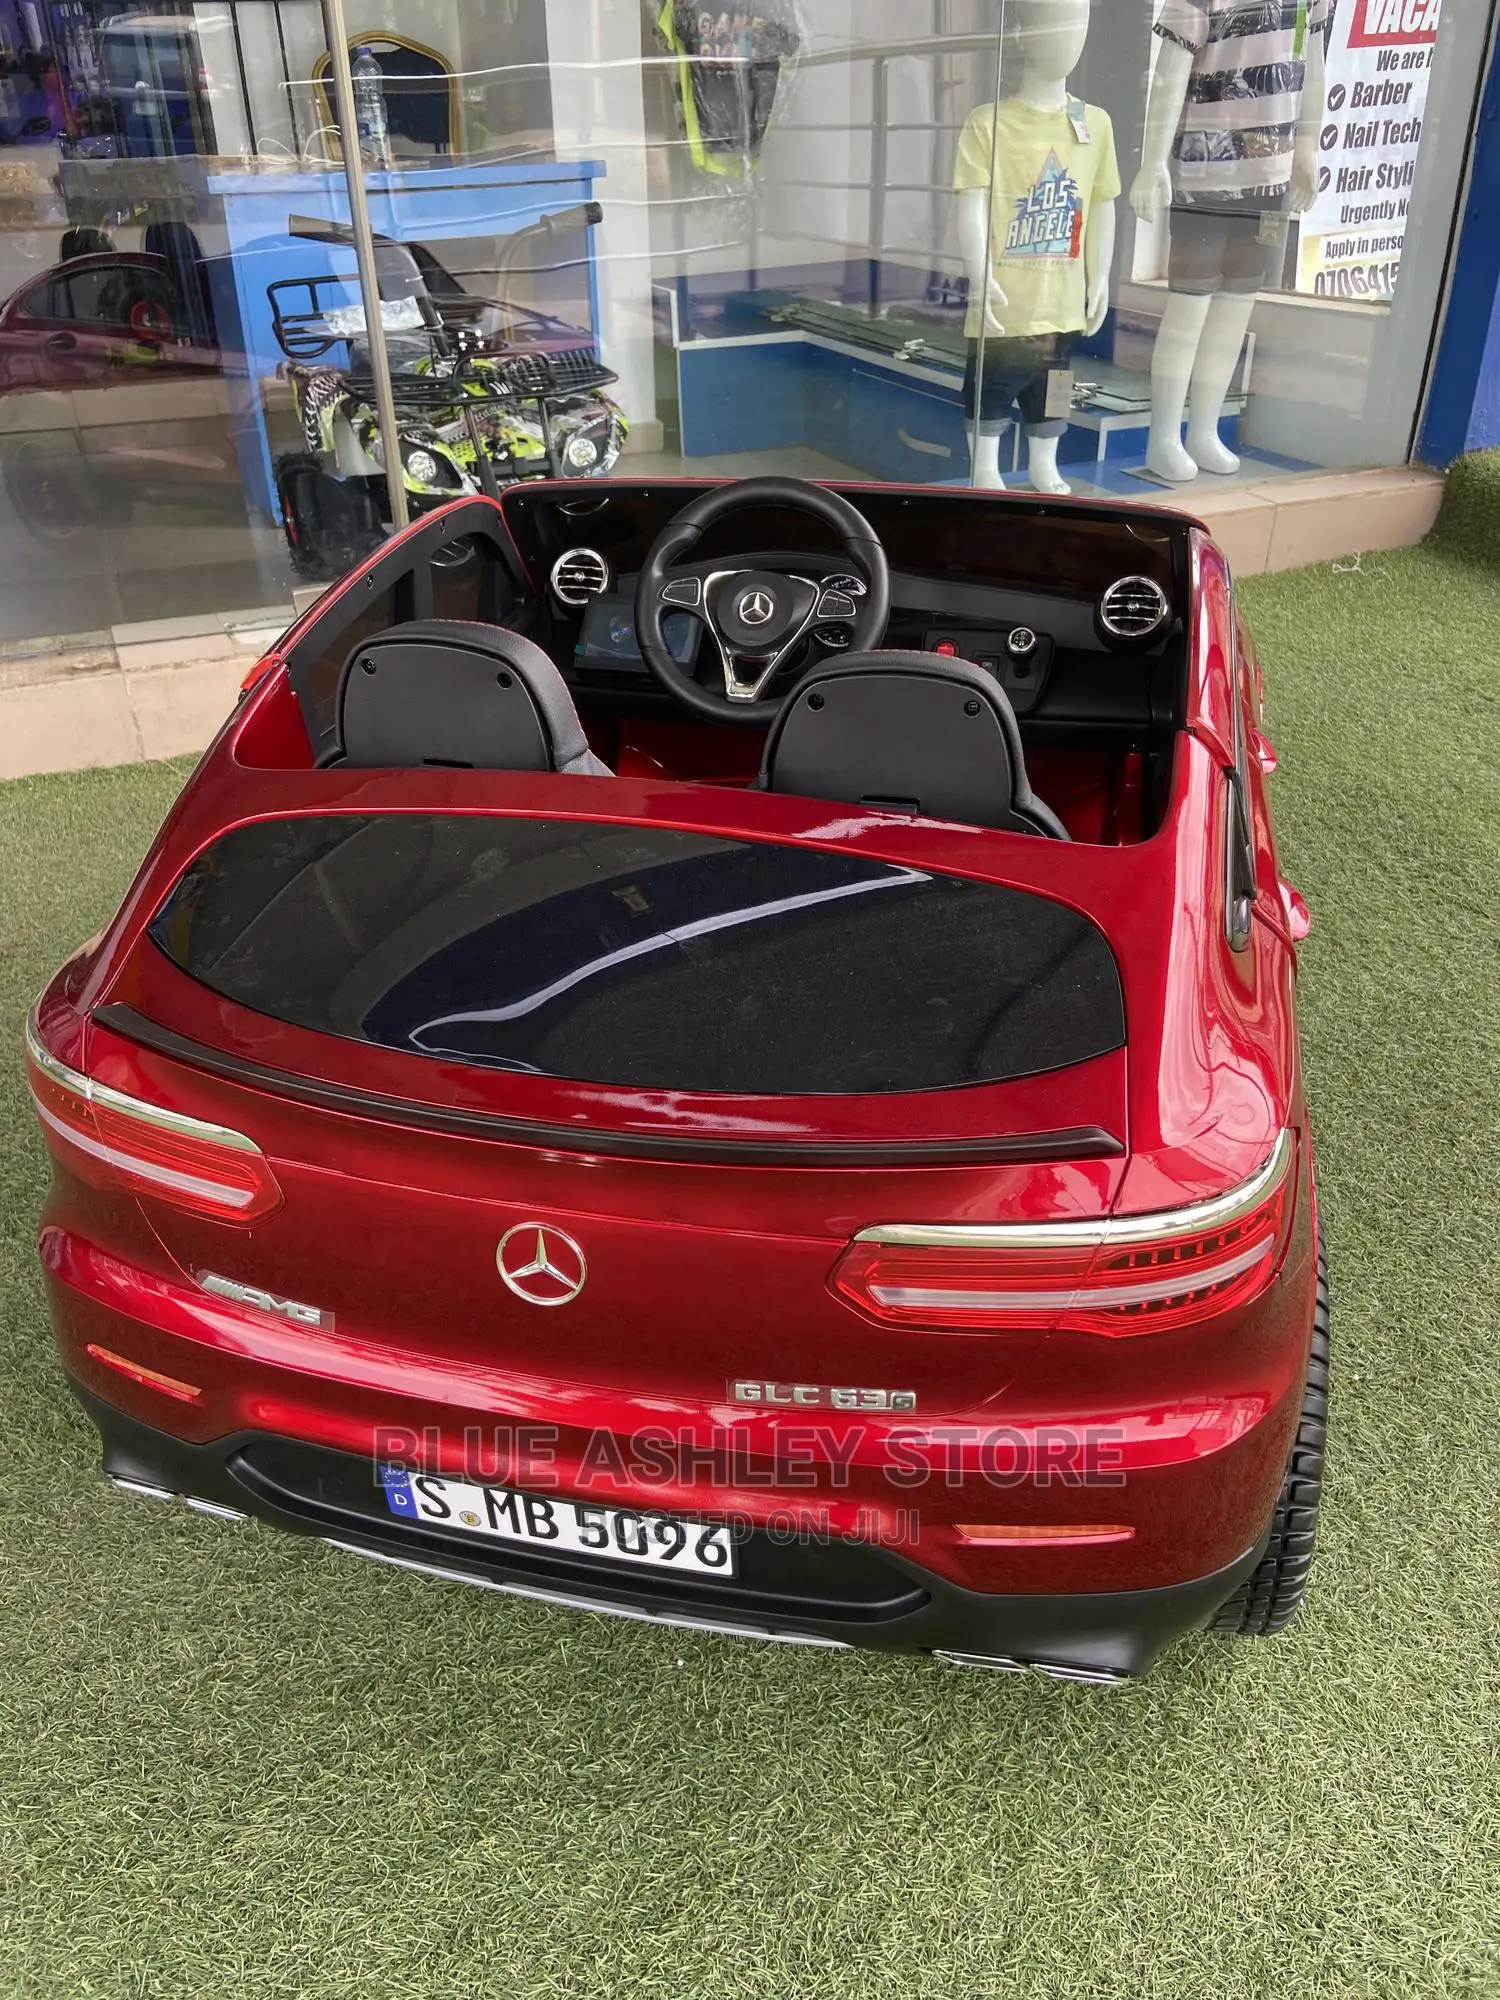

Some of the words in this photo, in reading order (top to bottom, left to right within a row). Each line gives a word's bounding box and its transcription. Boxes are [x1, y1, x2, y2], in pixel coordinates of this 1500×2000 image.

[1363, 0, 1441, 35] VACA
[1377, 50, 1399, 71] We
[1401, 51, 1425, 70] are
[1350, 79, 1413, 108] Barber
[1343, 120, 1379, 149] Nail
[1382, 117, 1421, 145] Tech
[1336, 165, 1373, 193] Hair
[1376, 160, 1415, 190] Styli
[1027, 180, 1072, 213] LOS
[1340, 200, 1396, 224] Urgently
[1006, 210, 1081, 249] ANGELE
[1325, 239, 1355, 259] Apply
[1357, 237, 1369, 254] in
[735, 1383, 819, 1404] GLC
[394, 1493, 408, 1506] D
[415, 1476, 451, 1519] S
[483, 1488, 560, 1540] MB
[576, 1508, 728, 1568] 5096
